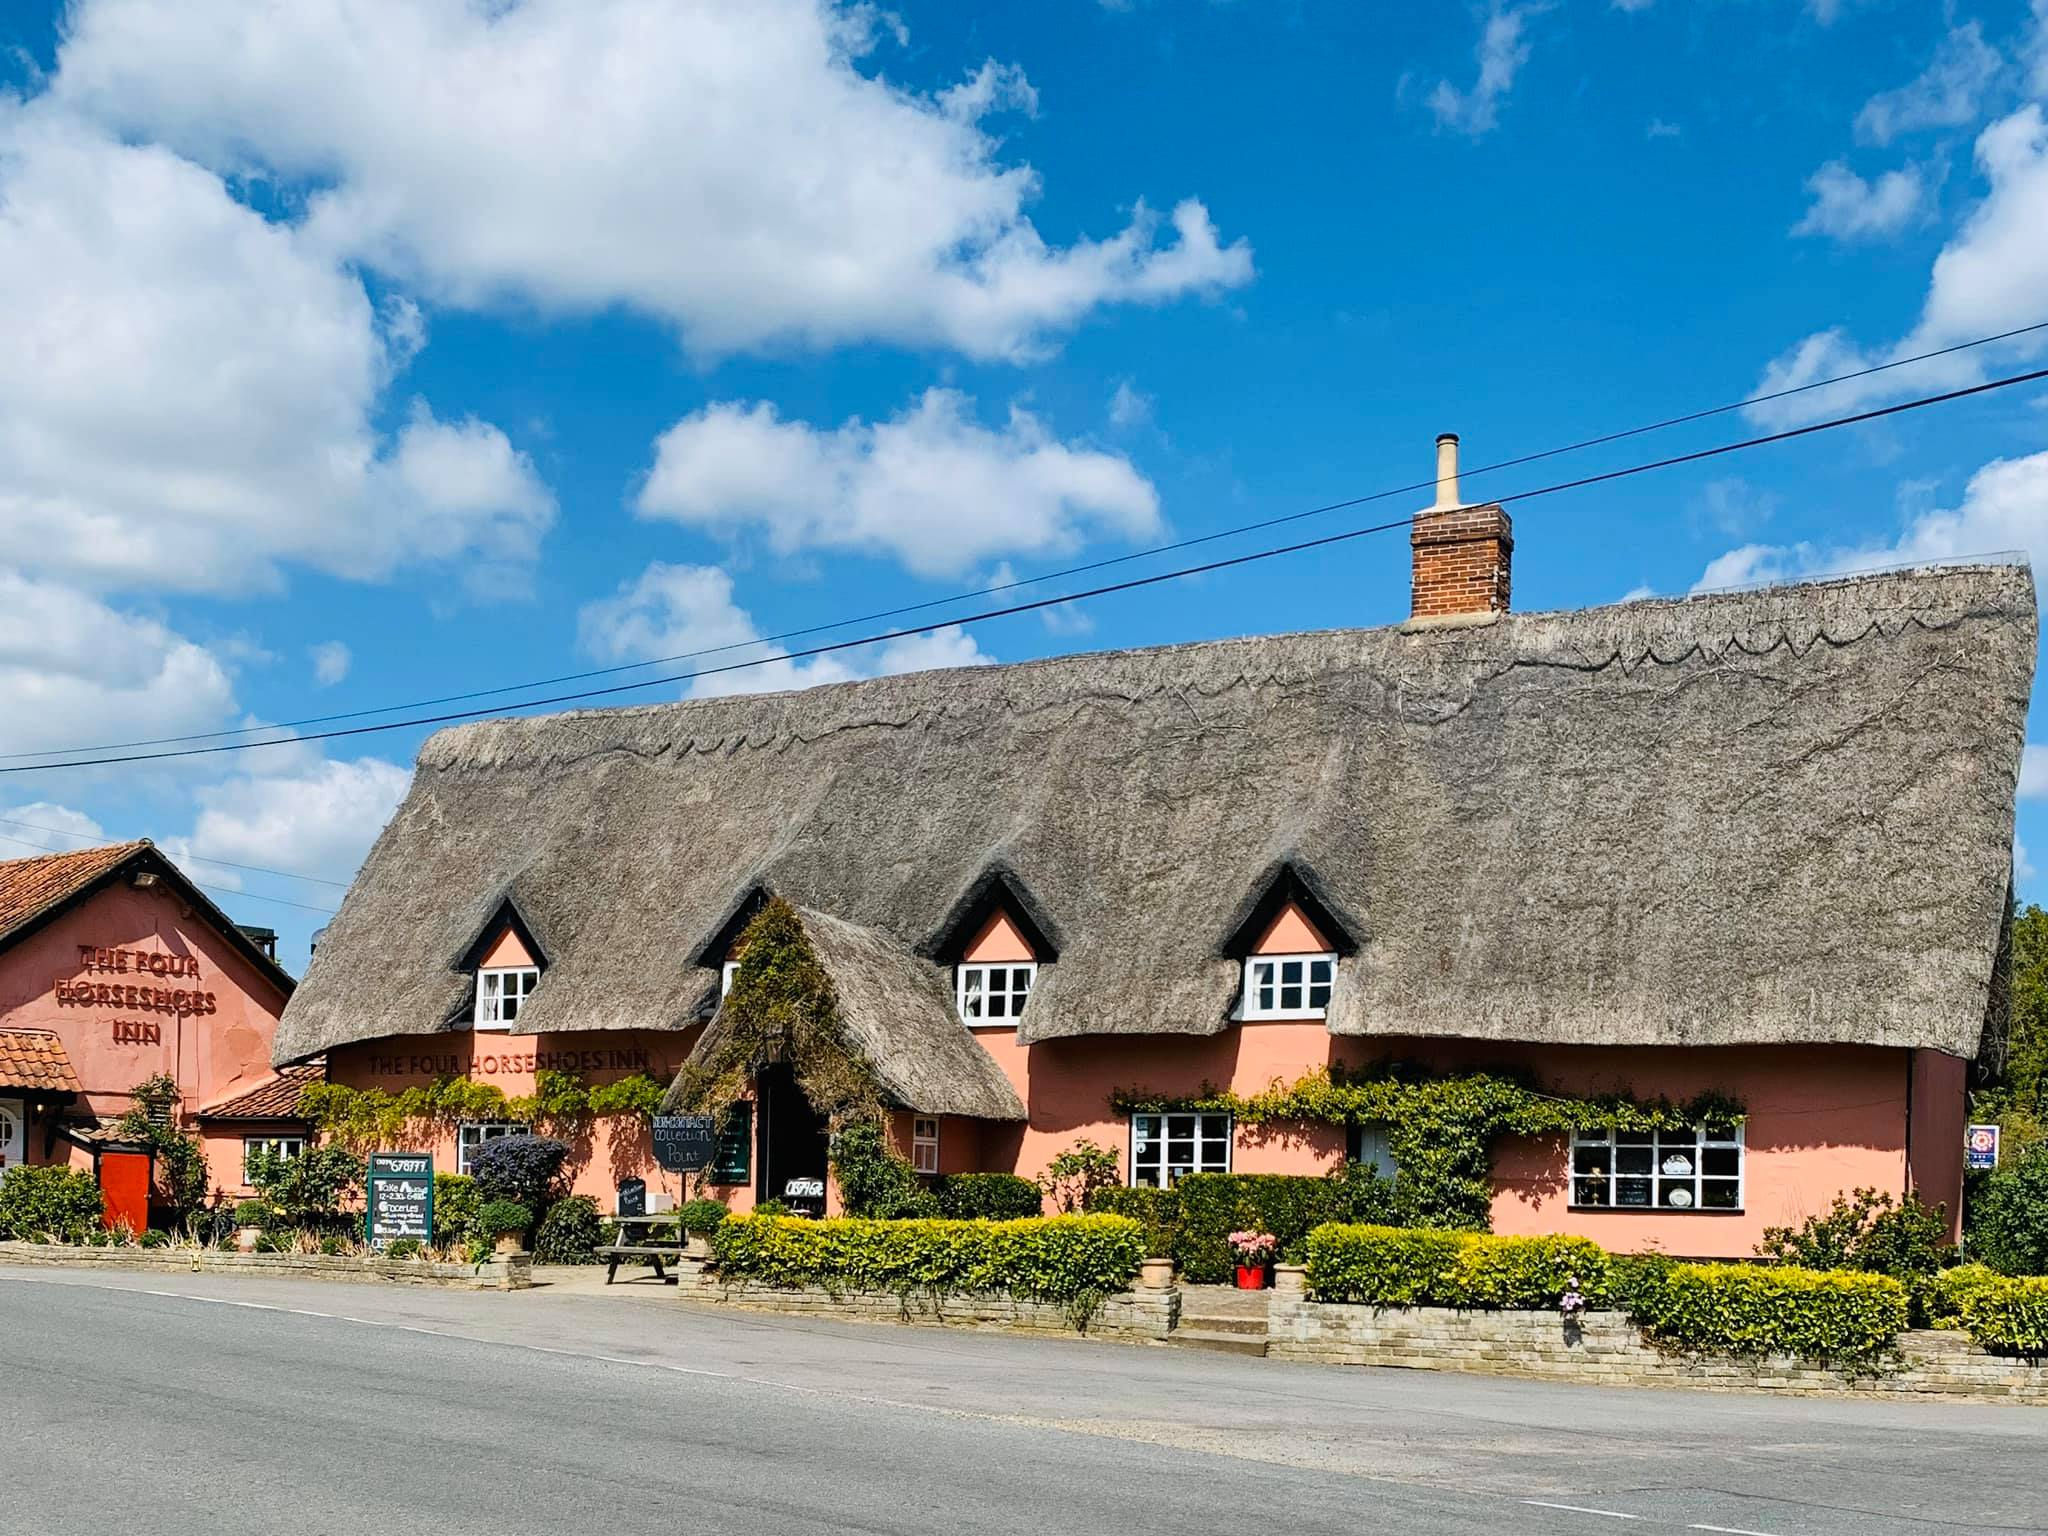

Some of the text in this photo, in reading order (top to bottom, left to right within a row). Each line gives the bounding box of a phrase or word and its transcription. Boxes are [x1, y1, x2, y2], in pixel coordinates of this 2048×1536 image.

[77, 945, 201, 980] THE FOUR
[54, 978, 217, 1017] HORSESHOES
[112, 1019, 161, 1047] INN
[368, 1048, 652, 1075] THE FOUR HORSESHOES INN
[374, 1181, 399, 1192] Take
